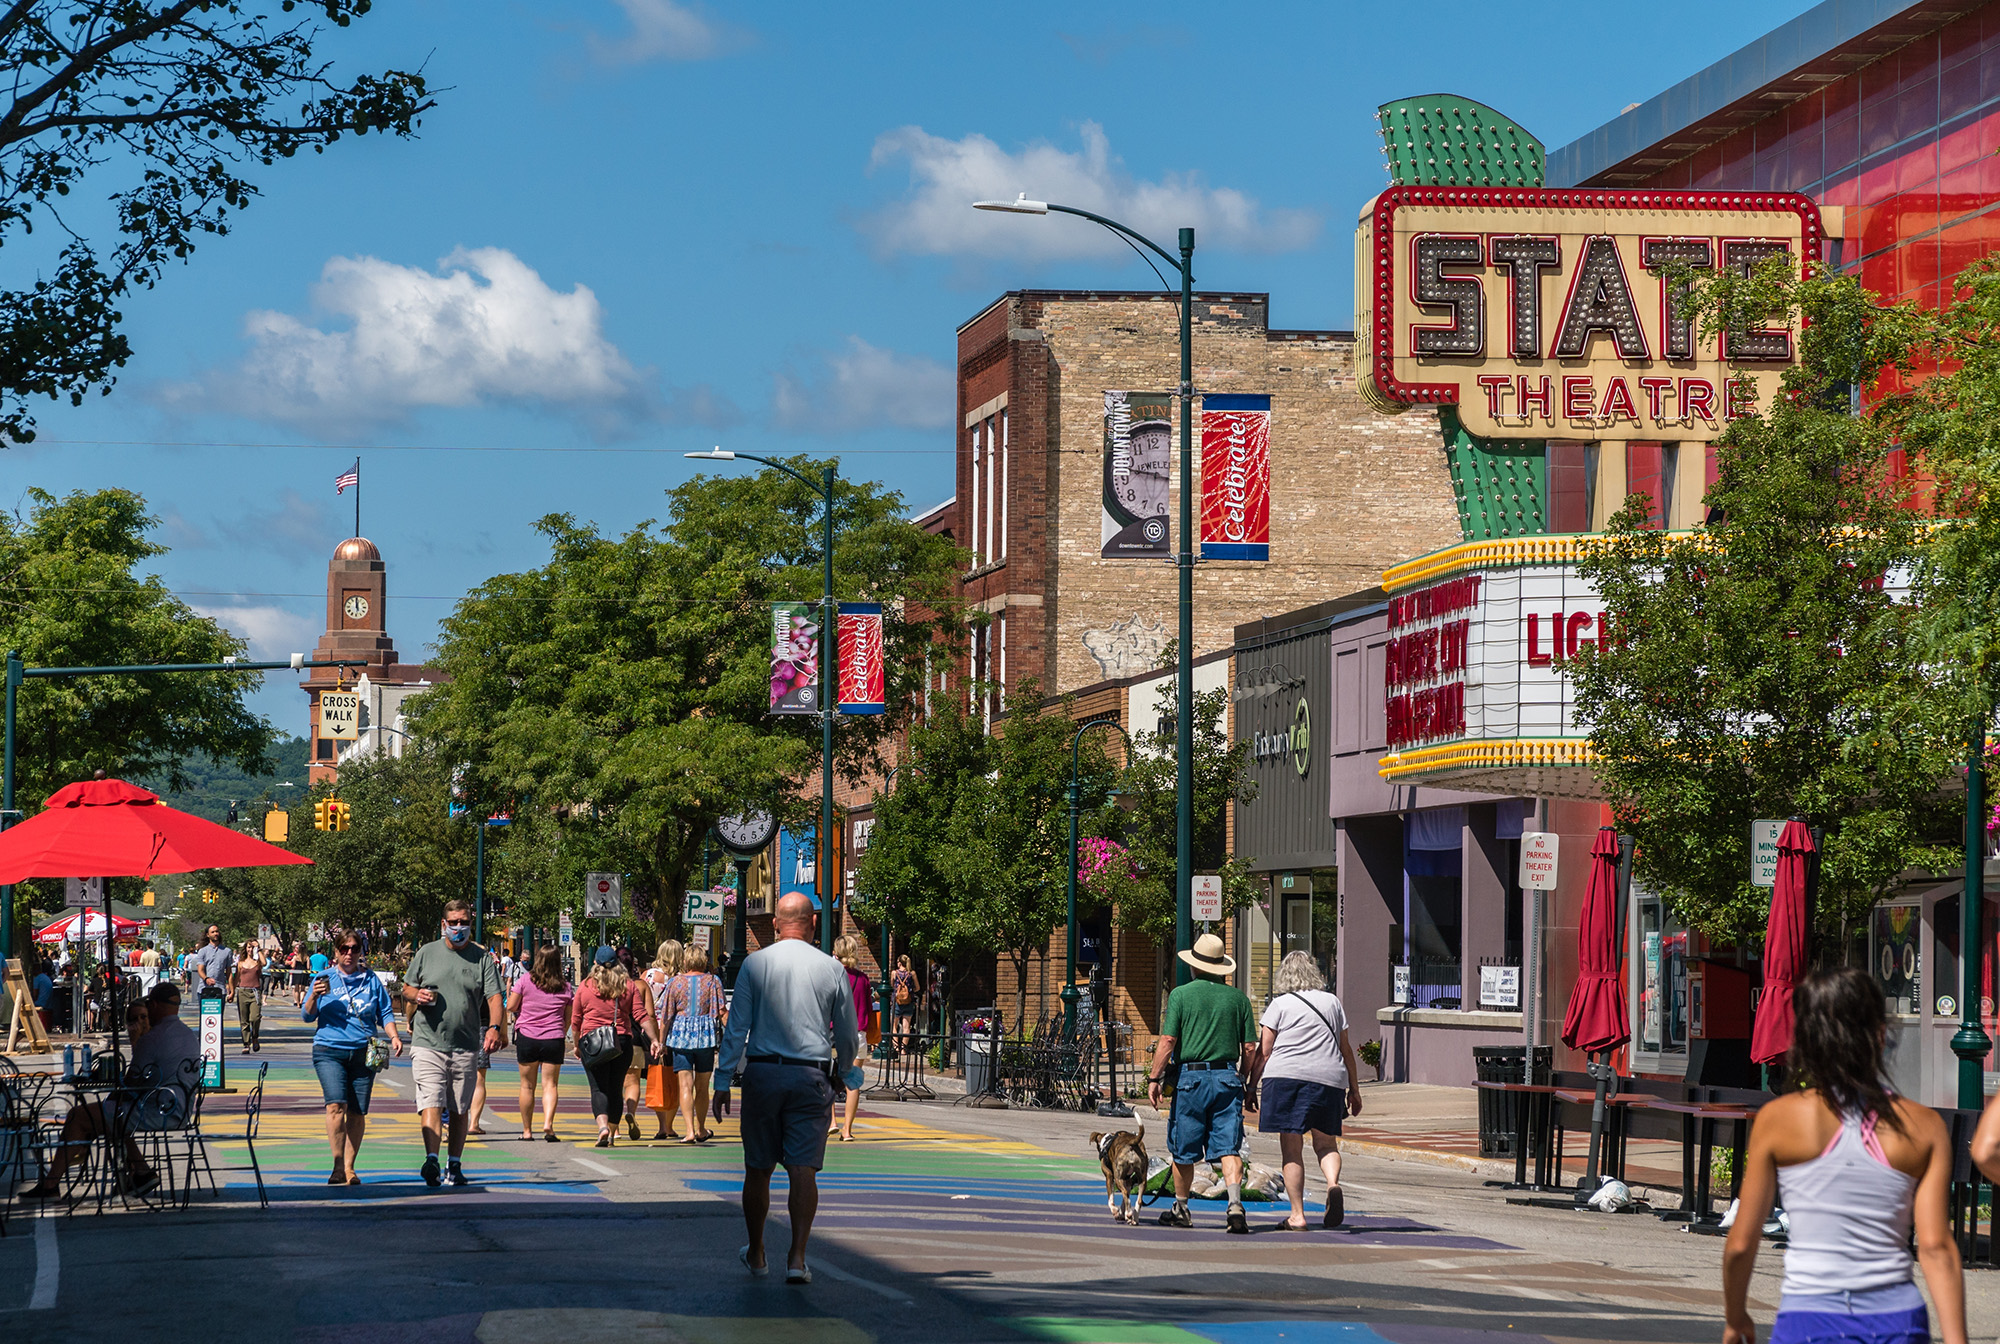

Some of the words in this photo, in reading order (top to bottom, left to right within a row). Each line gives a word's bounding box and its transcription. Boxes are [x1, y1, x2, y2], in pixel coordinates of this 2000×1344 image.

[1409, 233, 1793, 362] STATE
[1477, 374, 1757, 420] THEATRE
[1112, 402, 1131, 476] DOWNTOWN
[1137, 460, 1170, 472] JEWELE
[1225, 413, 1247, 542] Celebrate!
[1149, 526, 1159, 535] TC
[777, 610, 791, 659] DOWNTOWN
[853, 616, 868, 702] Celebrate!
[322, 696, 357, 708] CROSS
[325, 710, 353, 721] WALK
[1769, 829, 1778, 839] 15
[1535, 840, 1545, 848] NO
[1758, 842, 1779, 851] MINU
[1526, 850, 1553, 860] PARKING
[1755, 855, 1778, 864] LOAD
[1525, 862, 1553, 871] THEATER
[1531, 873, 1545, 881] EXIT
[1762, 868, 1777, 877] ZON
[688, 894, 720, 921] PARKING
